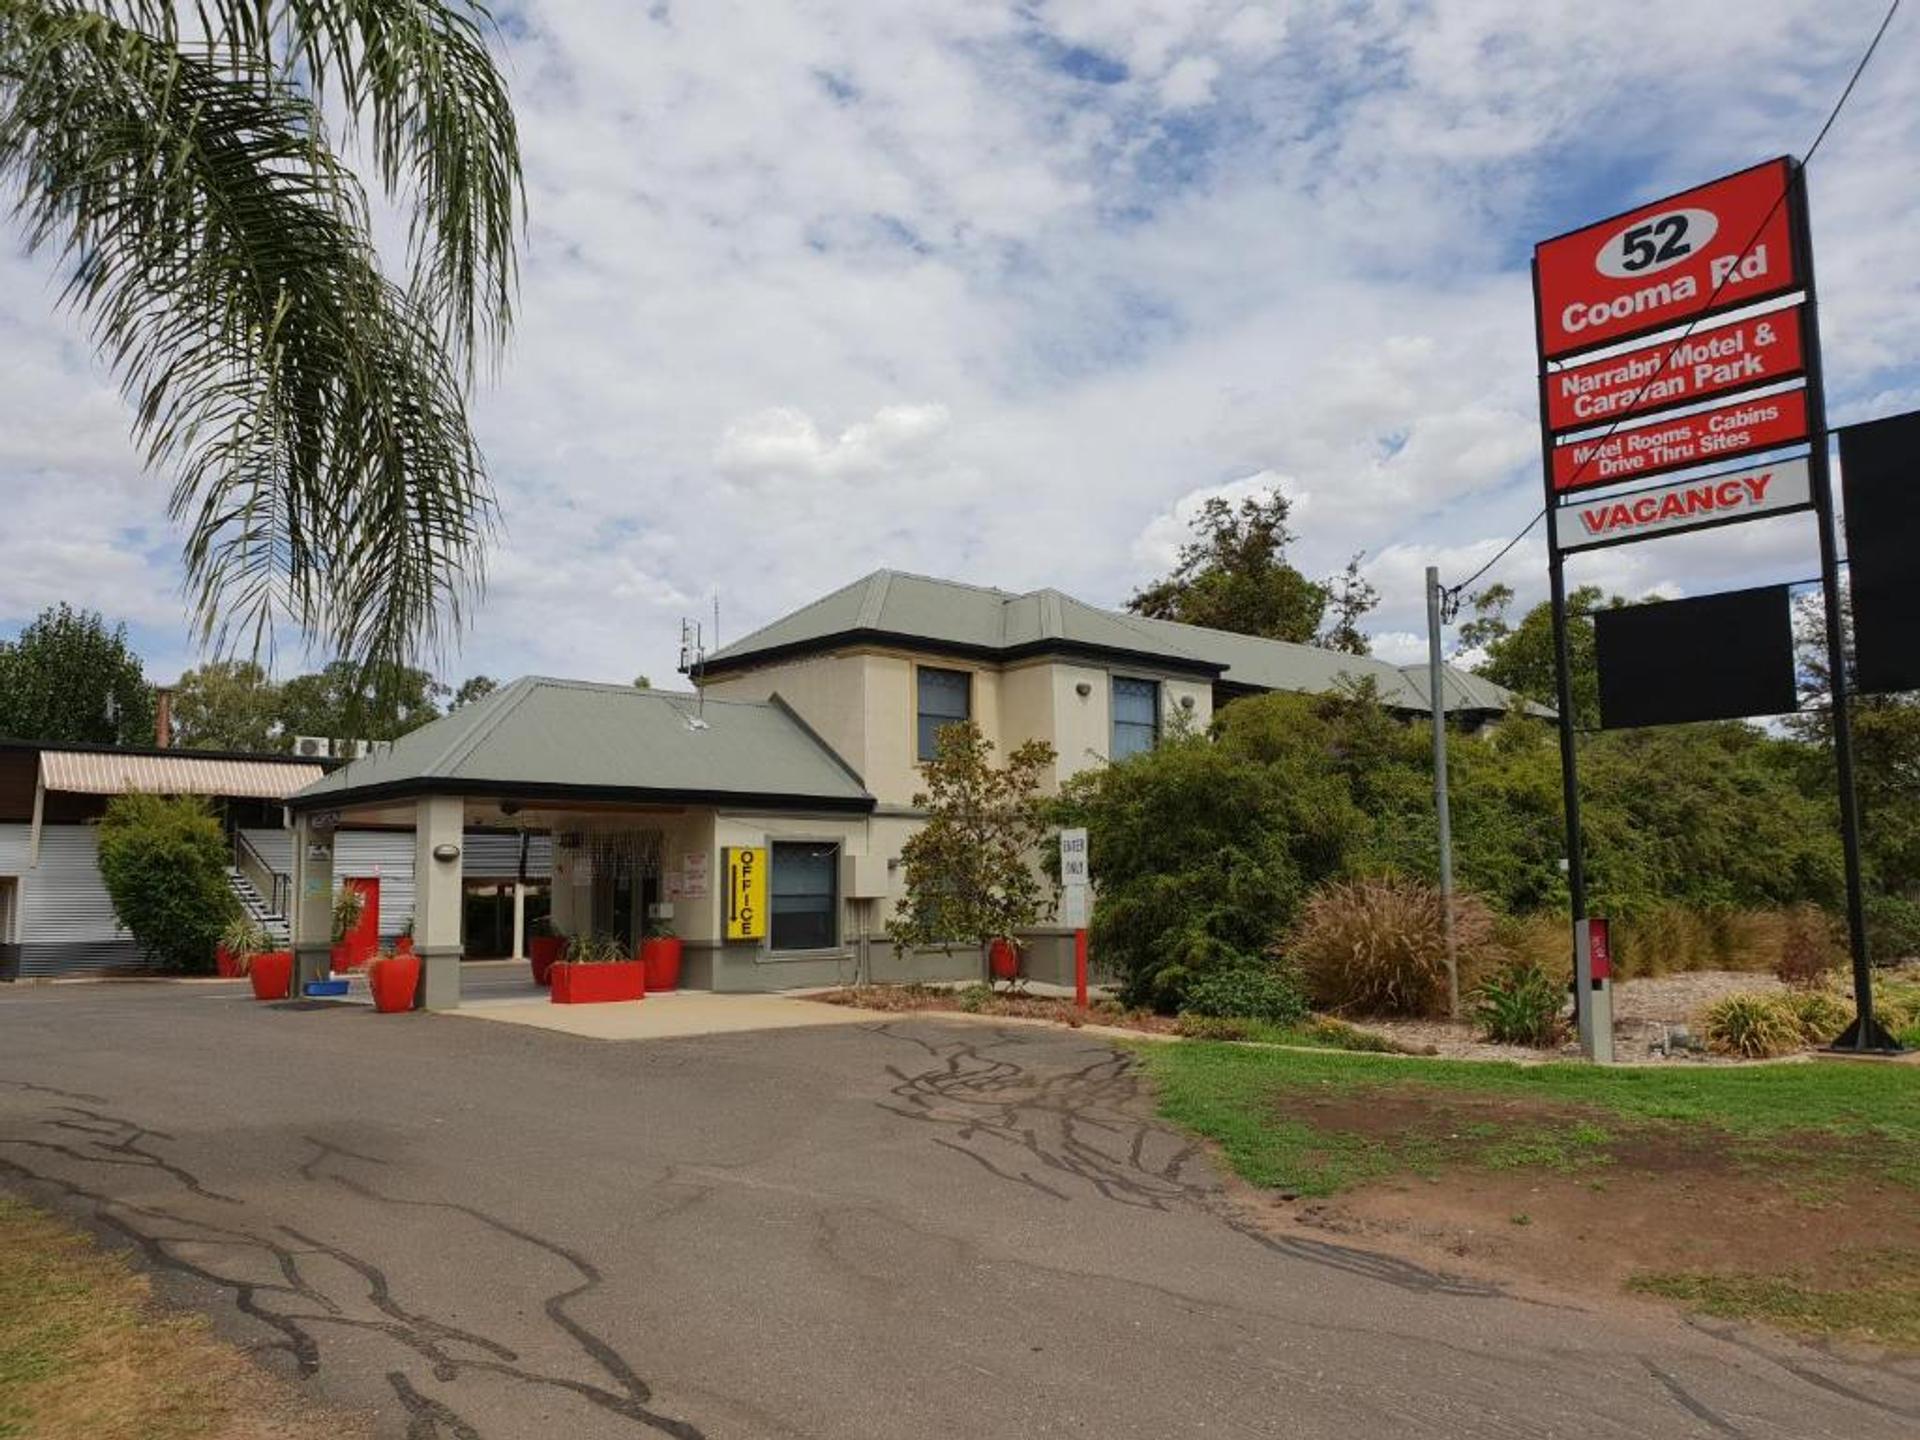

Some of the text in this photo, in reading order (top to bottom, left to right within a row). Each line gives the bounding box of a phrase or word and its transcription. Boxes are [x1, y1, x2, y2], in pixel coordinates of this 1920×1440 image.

[1622, 214, 1691, 271] 52
[1561, 244, 1768, 333] Cooma Rd
[1561, 322, 1777, 397] Narrabri Motel &
[1574, 353, 1765, 418] Caravan Park
[1573, 405, 1779, 464] Motel Rooms Cabins
[1600, 430, 1750, 475] Drive Thru Sites
[1579, 474, 1773, 535] VACANCY
[740, 851, 754, 935] OFFICE
